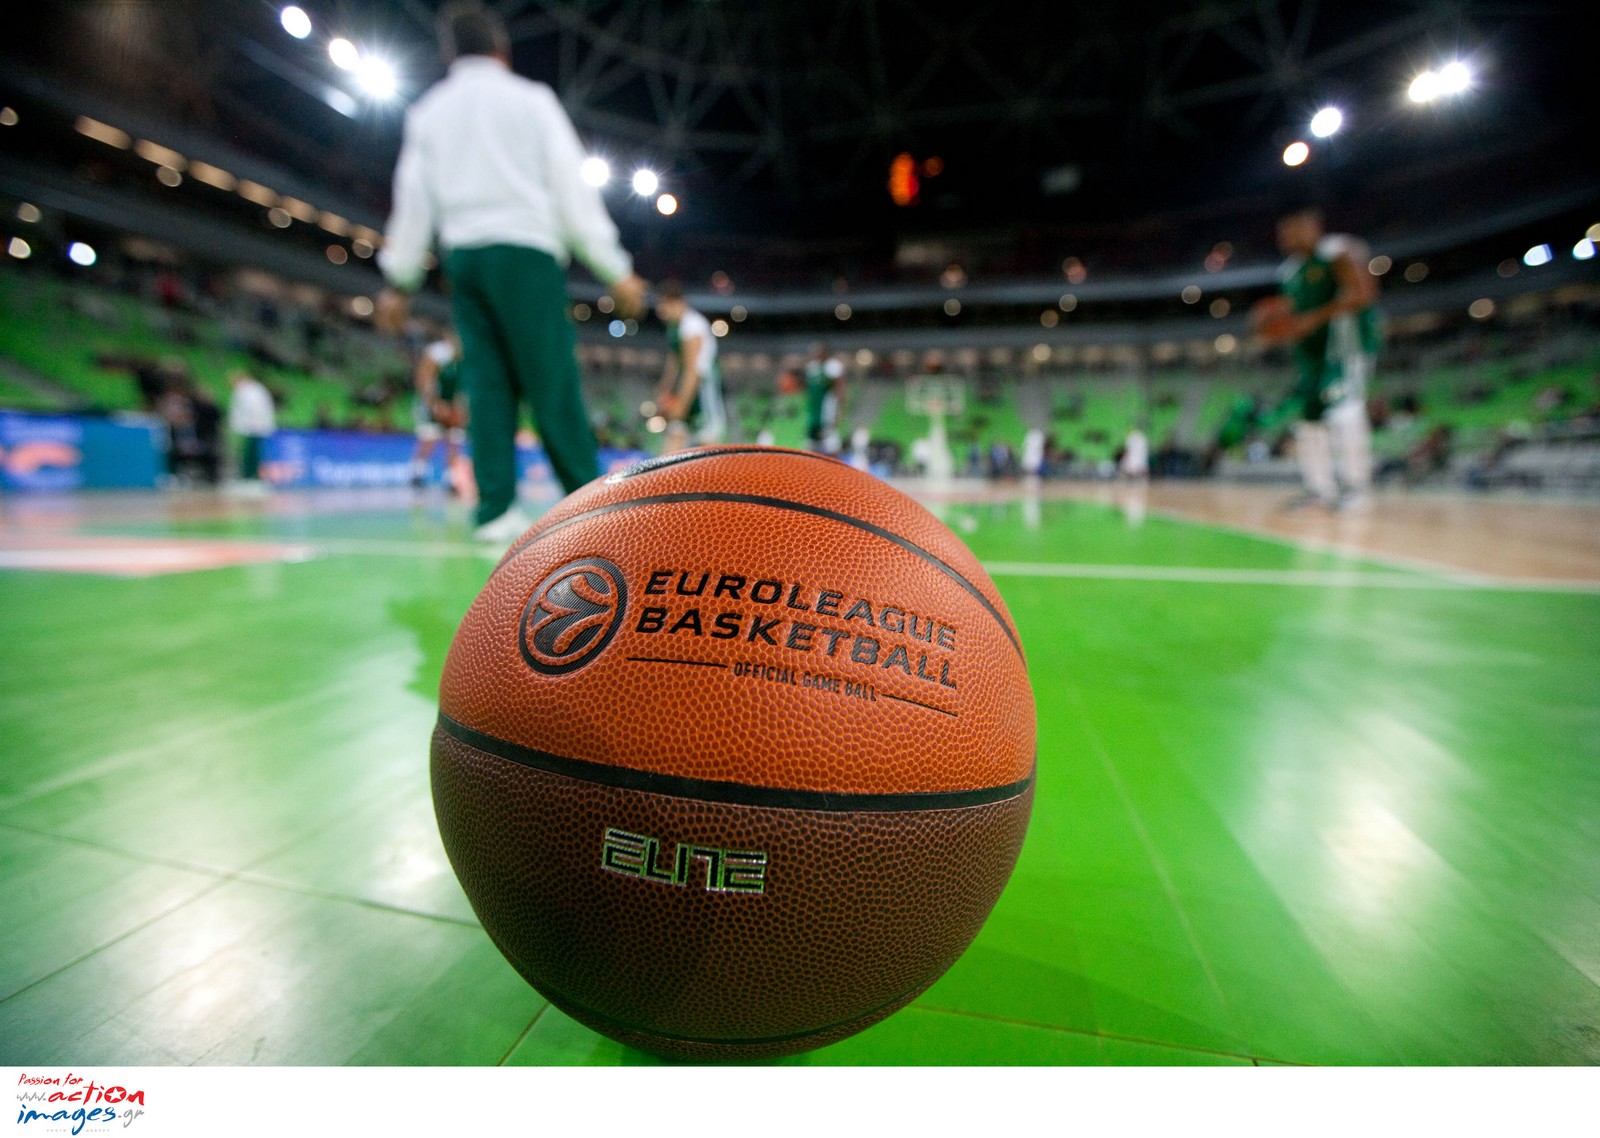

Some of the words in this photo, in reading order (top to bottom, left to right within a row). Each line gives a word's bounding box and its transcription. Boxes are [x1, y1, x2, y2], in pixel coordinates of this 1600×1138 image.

[644, 571, 957, 651] EUROLEAGUE
[636, 606, 958, 690] BASKETBALL
[733, 661, 797, 686] OFFICIAL
[802, 672, 842, 694] GAME
[845, 682, 877, 701] BALL
[602, 827, 768, 894] ELITE
